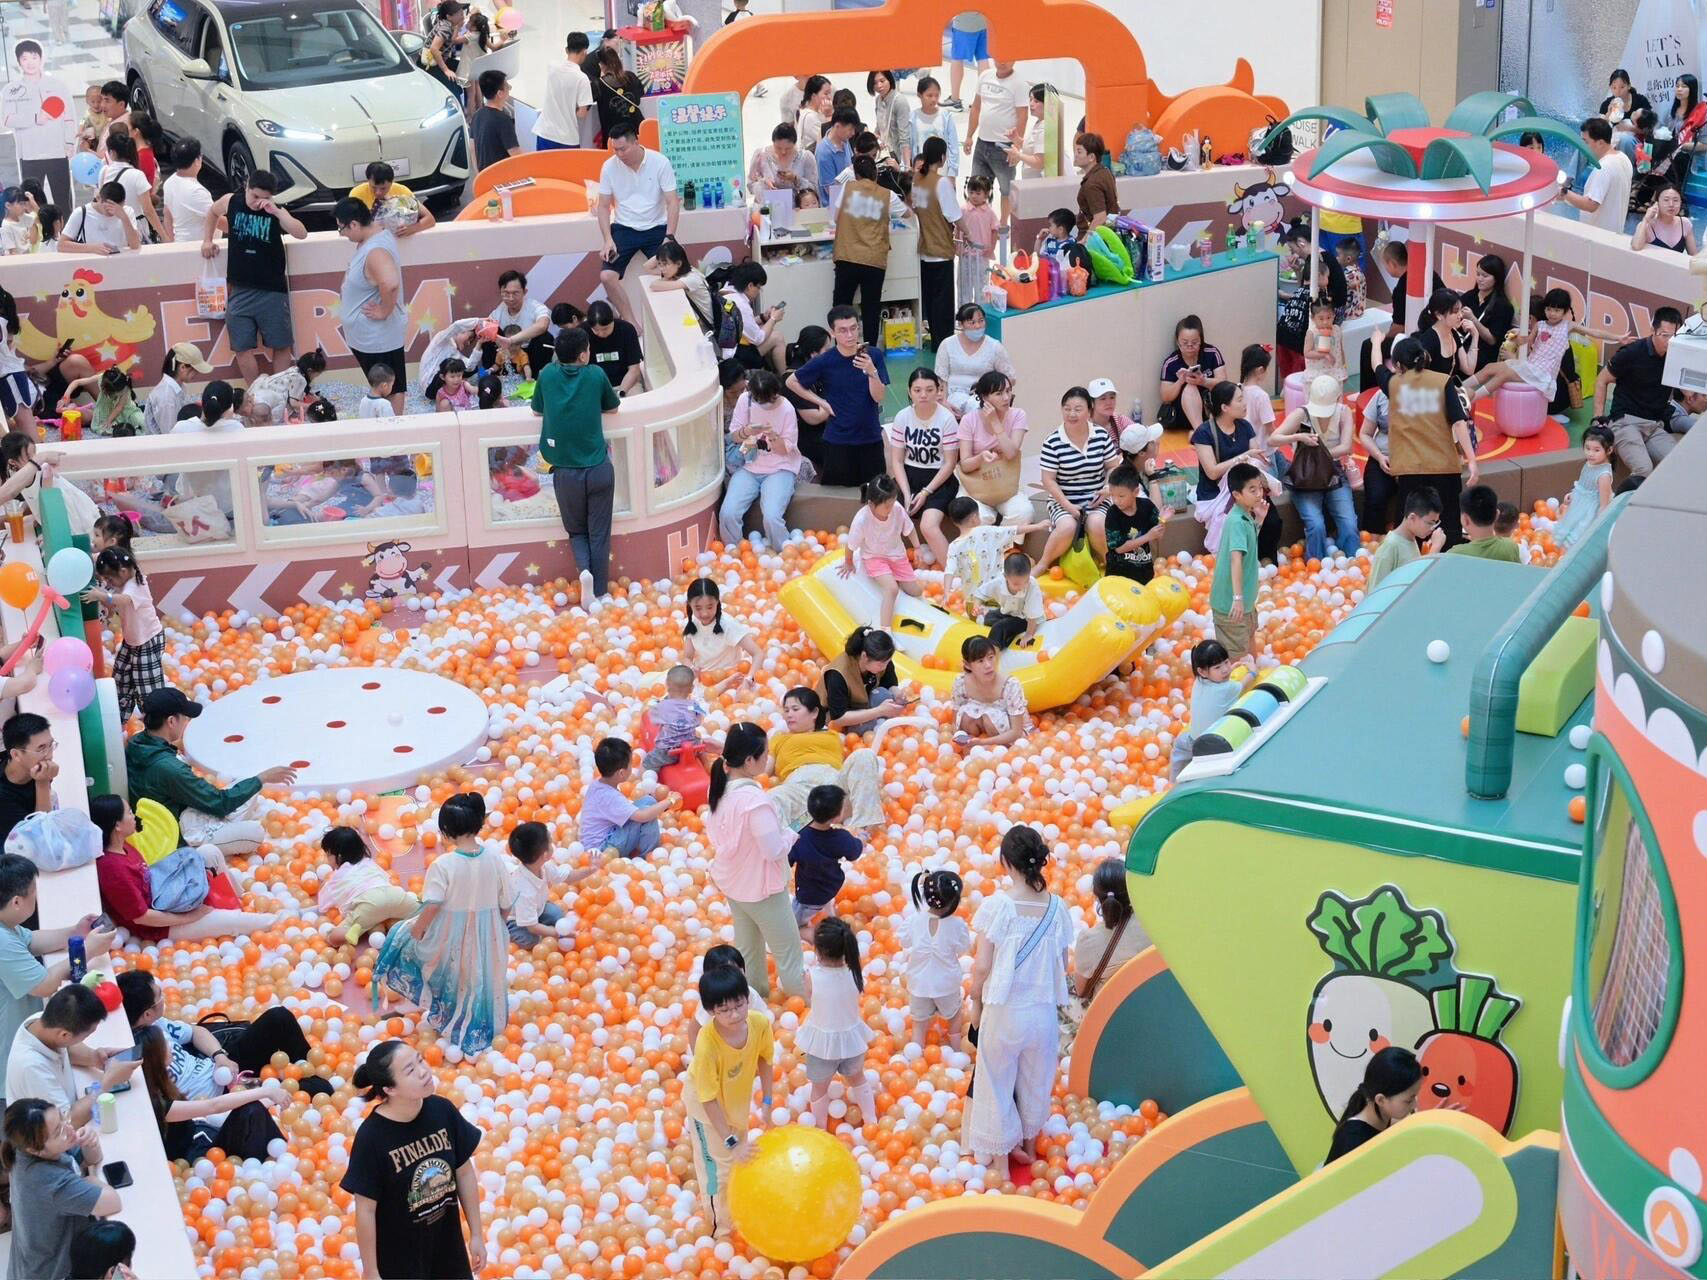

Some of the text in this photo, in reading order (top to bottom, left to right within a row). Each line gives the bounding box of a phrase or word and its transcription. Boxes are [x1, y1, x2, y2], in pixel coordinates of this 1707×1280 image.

[672, 104, 727, 124] 温馨提示
[1293, 120, 1317, 133] DISE
[904, 426, 941, 447] MISS
[905, 444, 941, 465] DIOR
[389, 1128, 452, 1173] FINALDE
